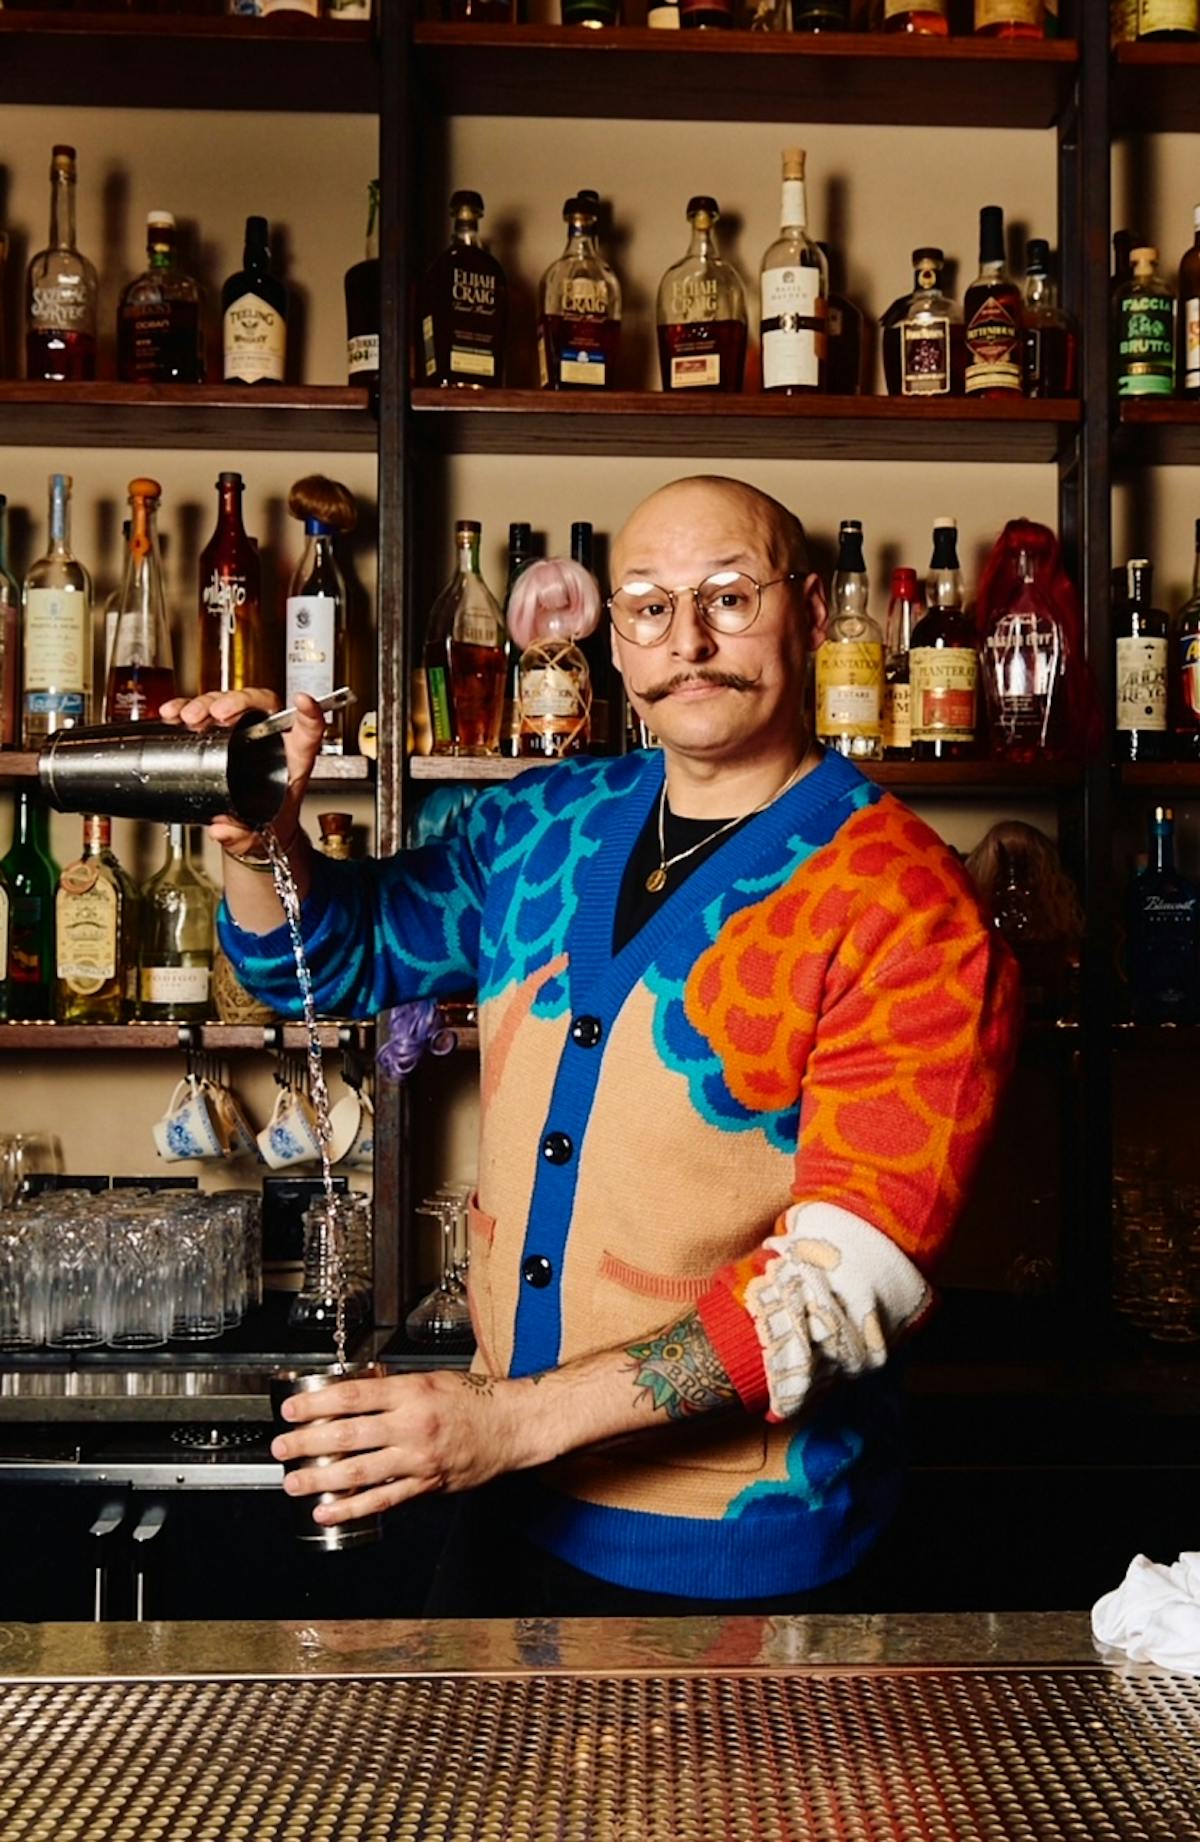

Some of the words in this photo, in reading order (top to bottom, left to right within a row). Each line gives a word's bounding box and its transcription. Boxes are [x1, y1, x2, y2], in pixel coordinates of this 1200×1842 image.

[453, 267, 496, 289] ELIJAH
[452, 284, 495, 305] CRAIG
[672, 280, 717, 297] ELIJAH
[562, 297, 606, 314] CRAIG
[1121, 297, 1171, 312] FACCIA
[230, 308, 275, 326] TEELING
[1120, 339, 1172, 354] BRUTTO
[667, 1365, 707, 1402] BRO
